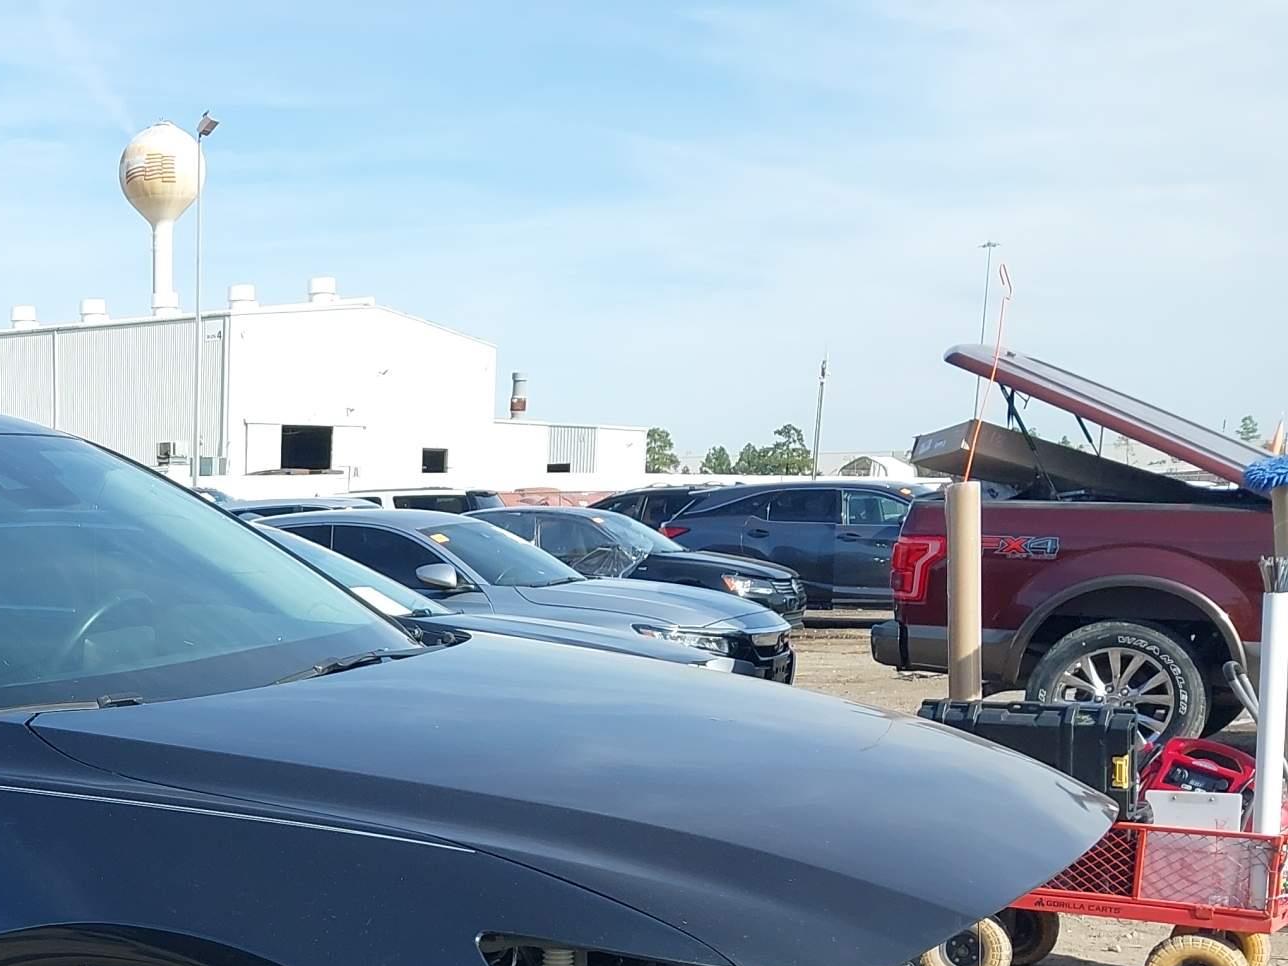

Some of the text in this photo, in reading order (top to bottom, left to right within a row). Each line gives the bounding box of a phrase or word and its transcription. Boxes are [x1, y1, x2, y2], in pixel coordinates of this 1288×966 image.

[1117, 634, 1189, 716] WRANGLER
[1046, 900, 1121, 914] GORILLA CARTS
